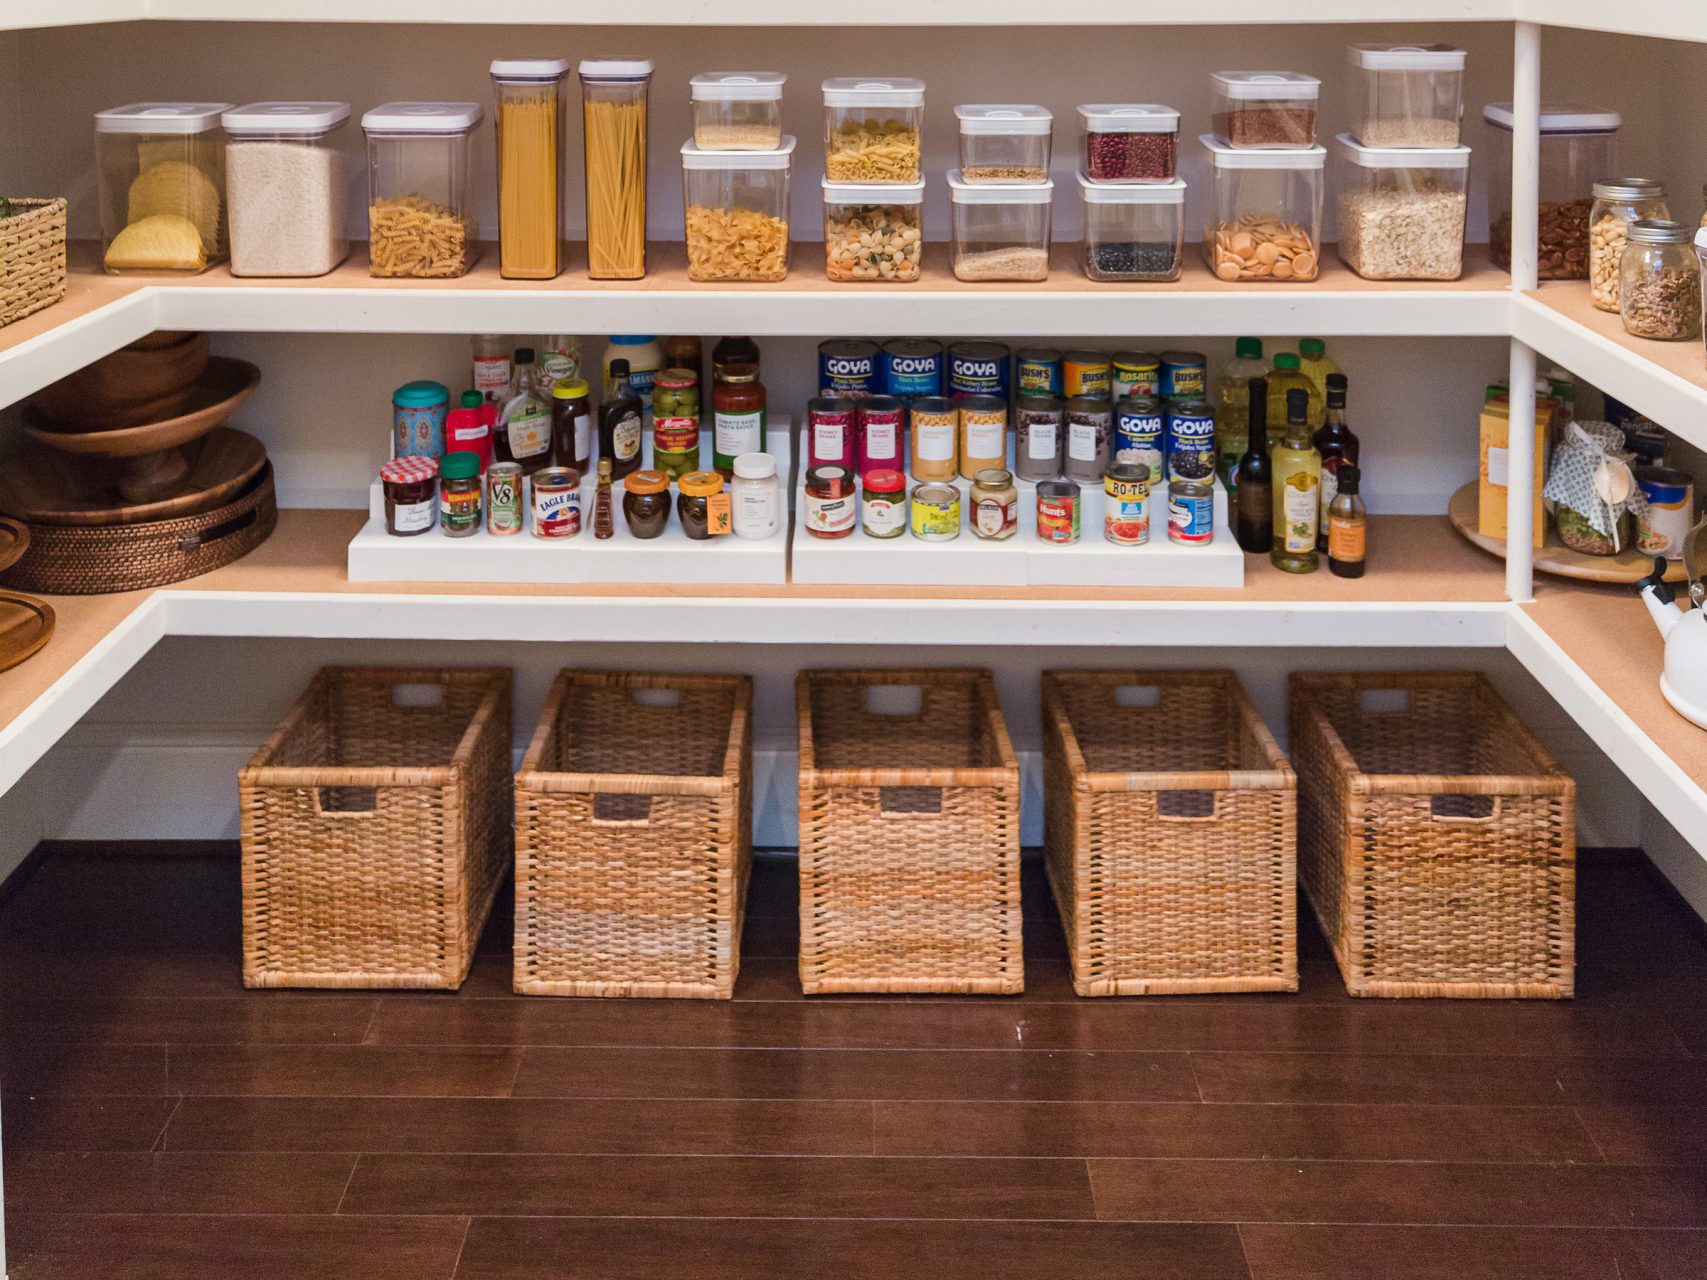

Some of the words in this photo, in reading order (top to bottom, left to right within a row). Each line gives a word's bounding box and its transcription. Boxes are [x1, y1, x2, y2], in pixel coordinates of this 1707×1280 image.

[828, 360, 871, 374] GOYA
[892, 358, 935, 372] GOYA
[953, 360, 997, 376] GOYA
[1120, 417, 1161, 432] GOYA
[1172, 419, 1214, 434] GOYA
[493, 483, 511, 504] V8
[540, 496, 565, 511] EAGLE
